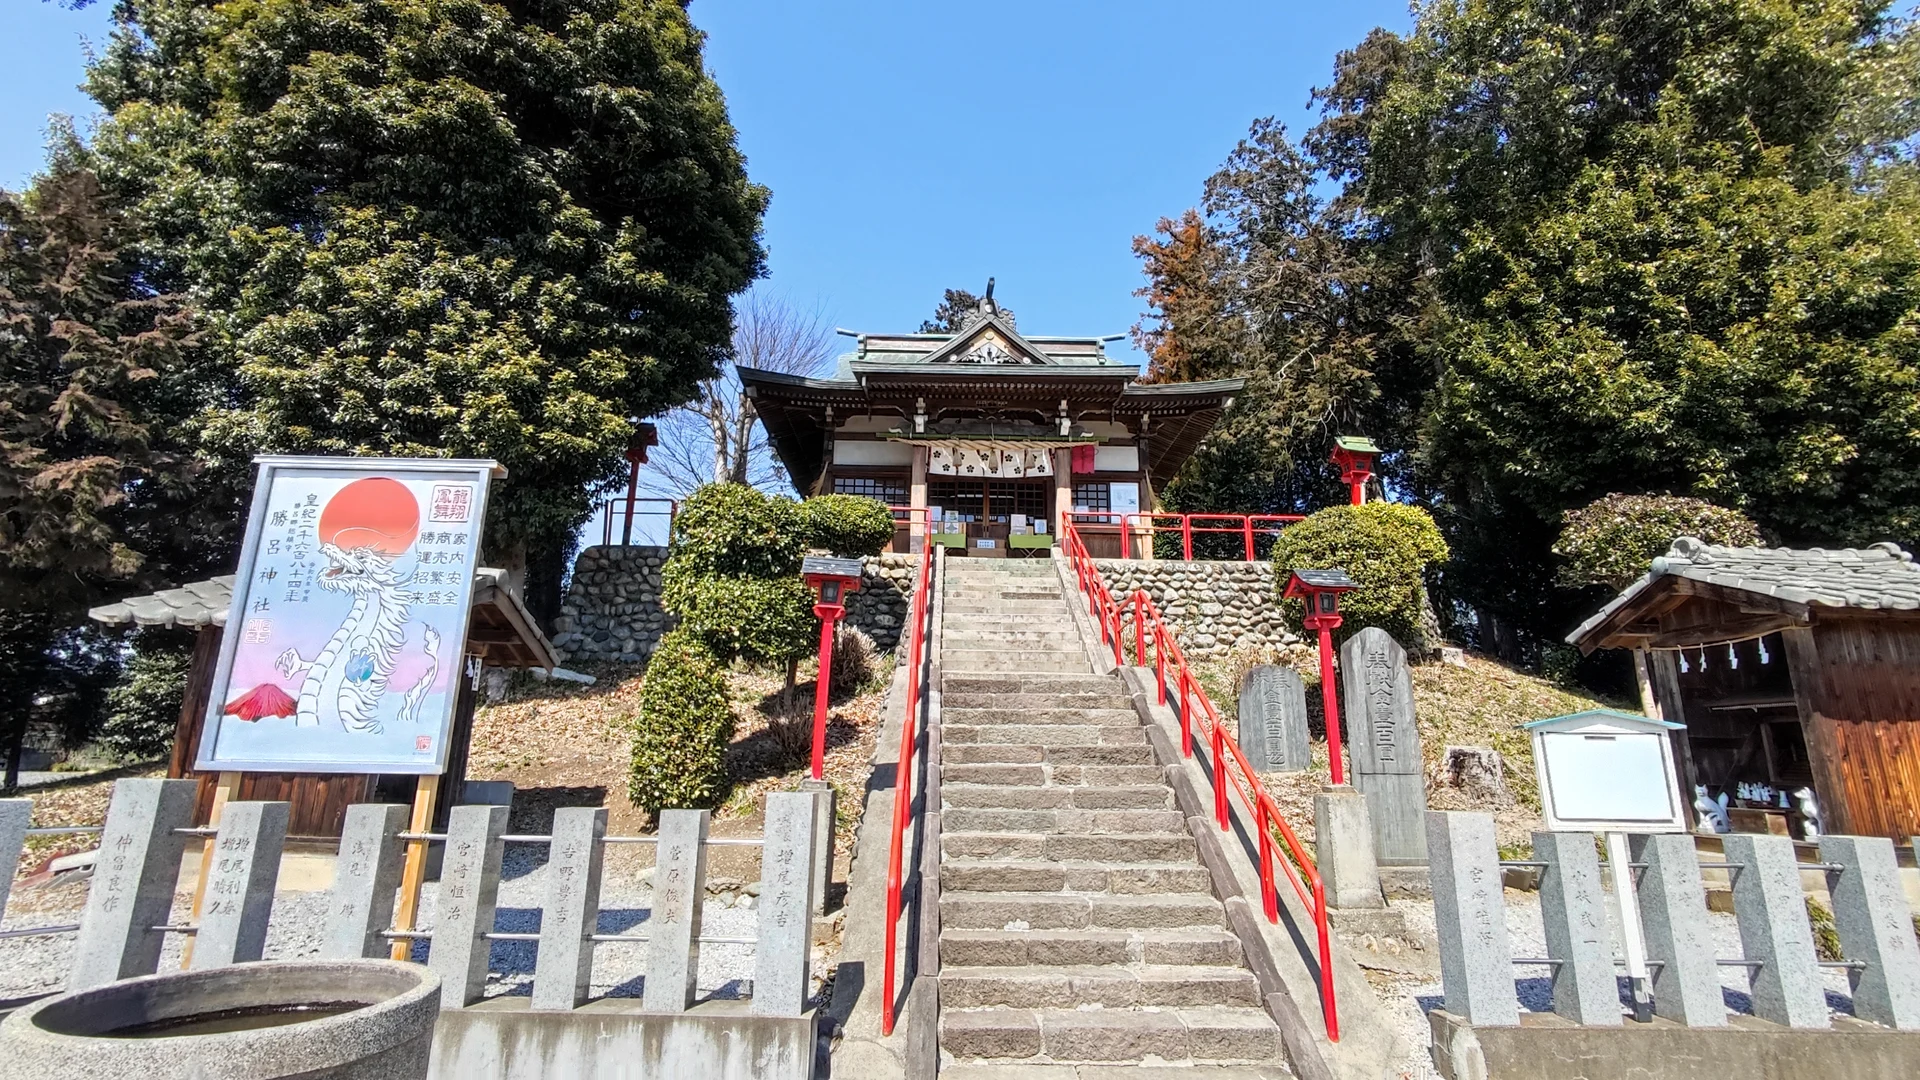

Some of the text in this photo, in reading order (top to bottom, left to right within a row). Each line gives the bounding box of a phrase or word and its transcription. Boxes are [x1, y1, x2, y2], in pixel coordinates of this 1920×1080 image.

[252, 510, 288, 613] 勝呂神社
[410, 531, 436, 605] 勝運招来
[426, 531, 452, 605] 商売繁盛
[443, 533, 468, 605] 家内安全
